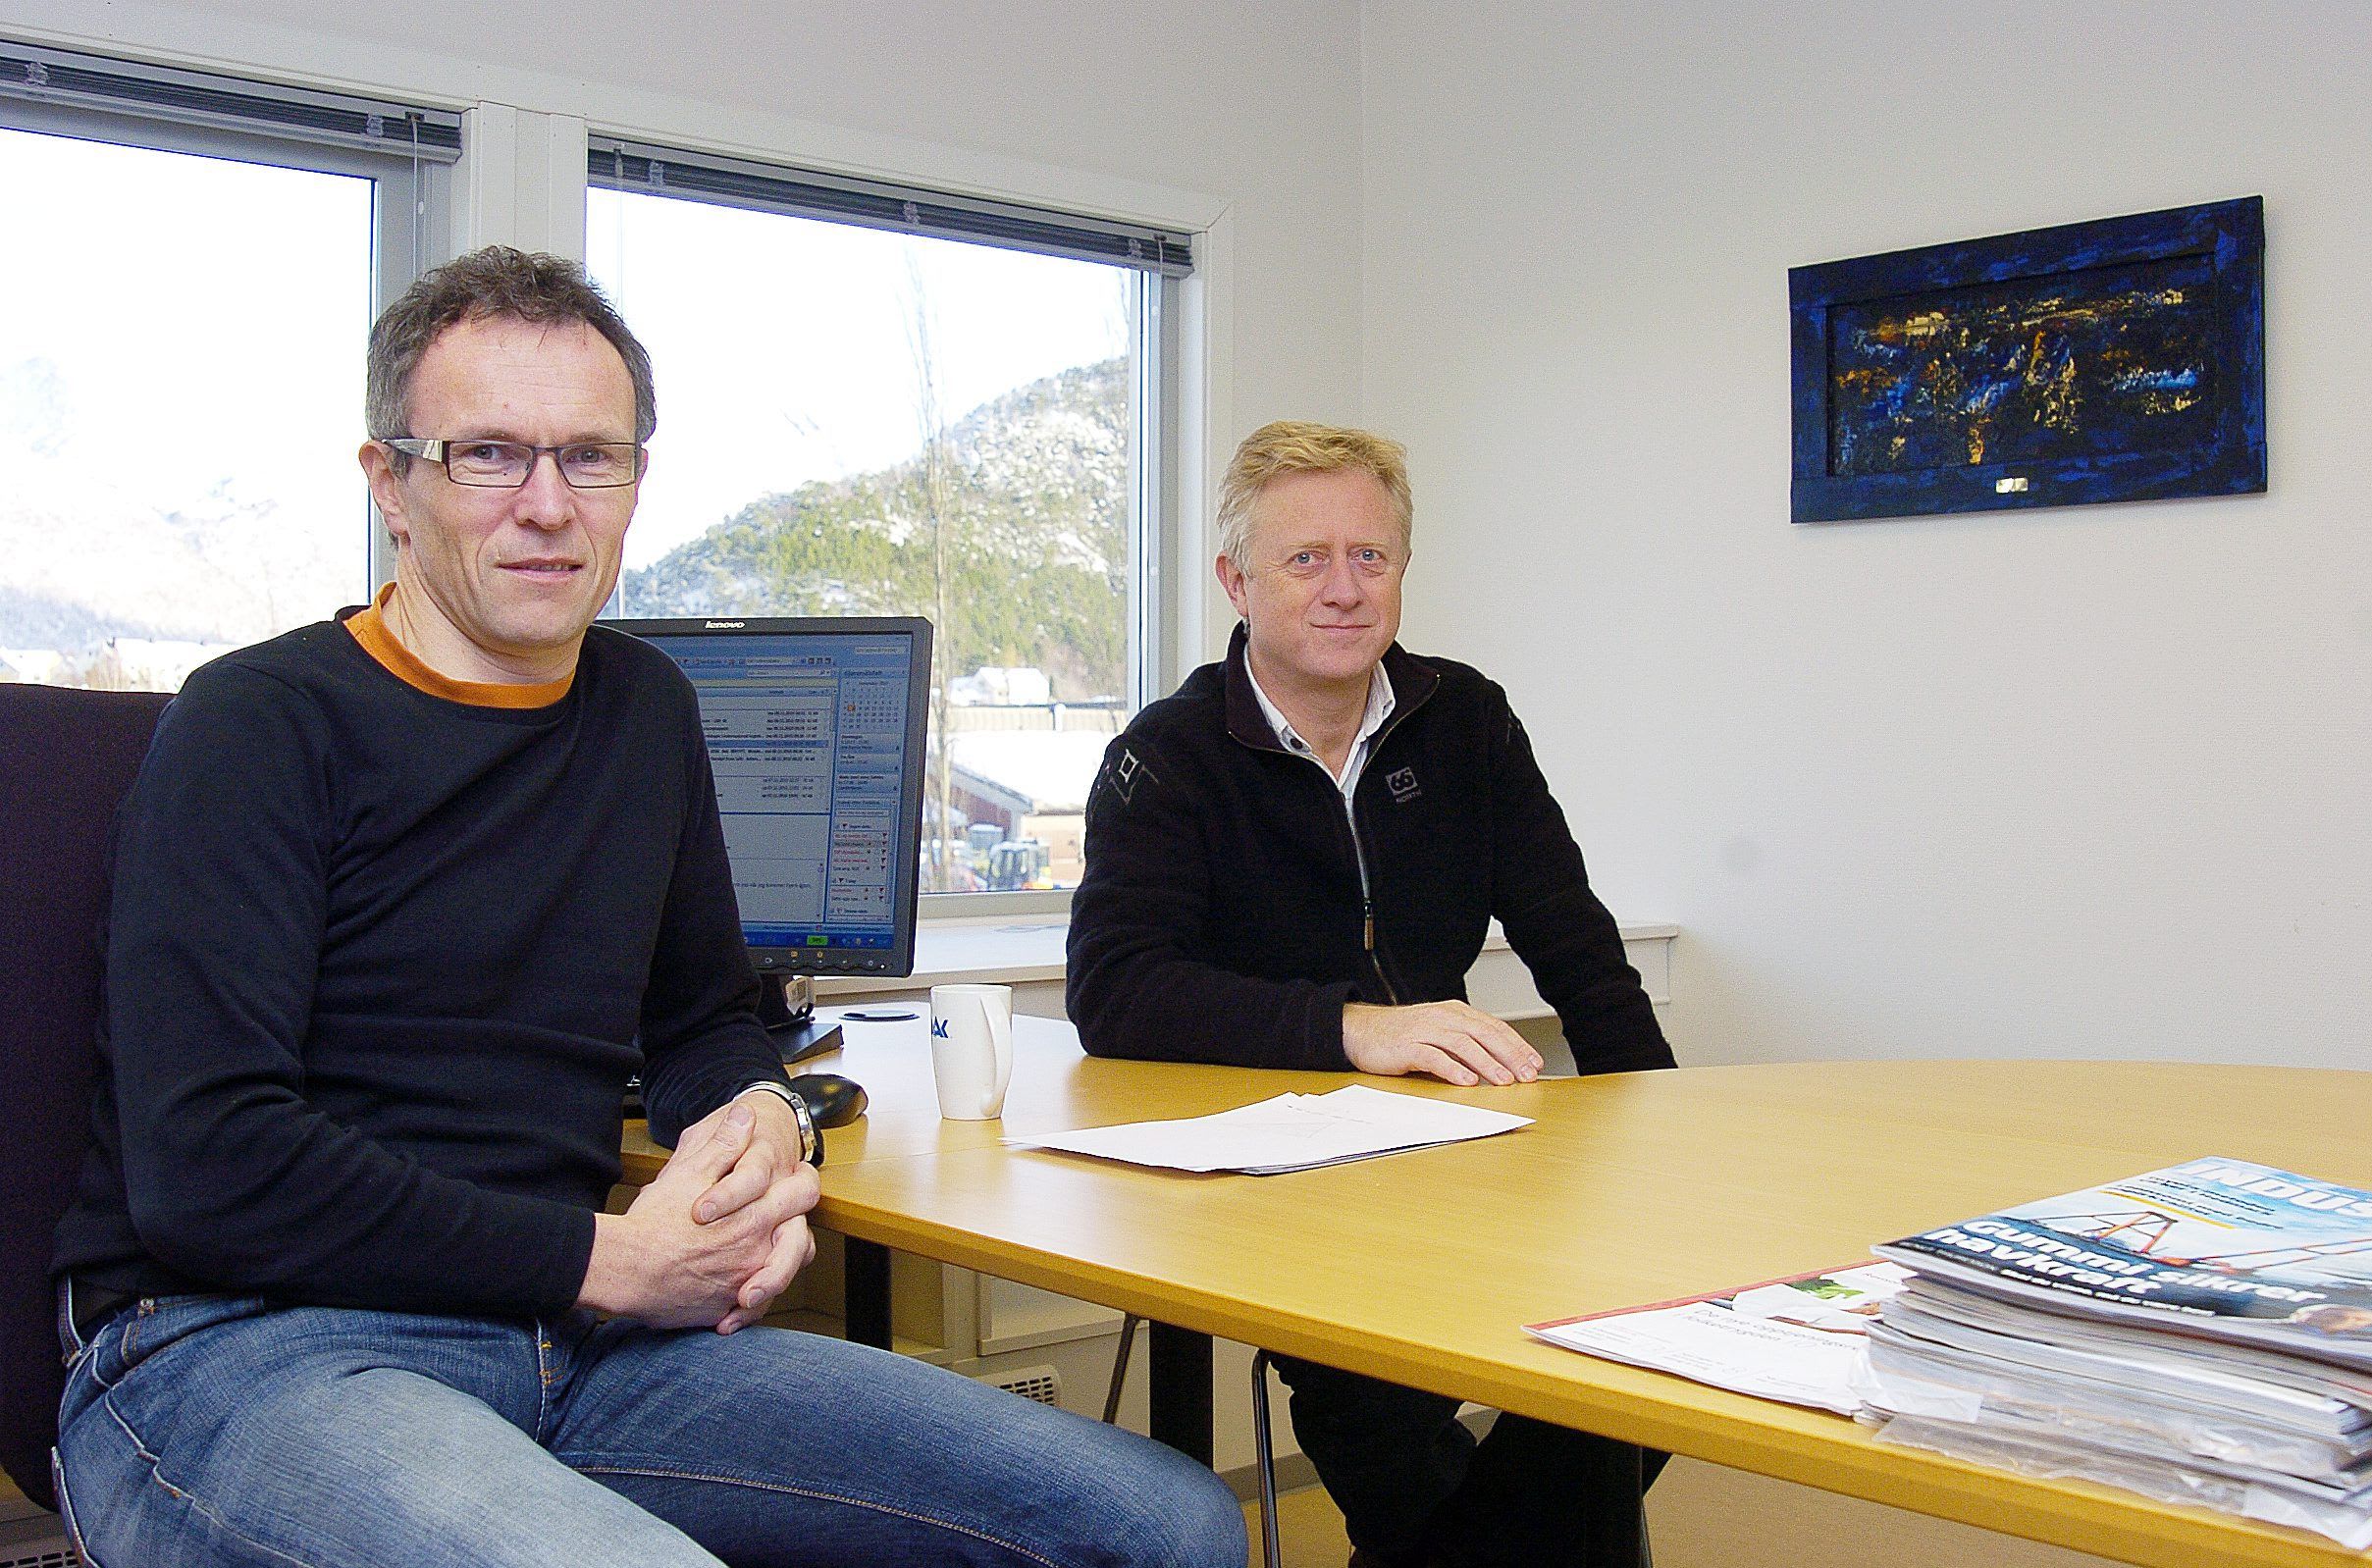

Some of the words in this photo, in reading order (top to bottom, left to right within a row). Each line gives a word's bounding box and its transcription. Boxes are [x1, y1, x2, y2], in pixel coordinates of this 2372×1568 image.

[705, 620, 746, 629] lenovo
[1923, 1228, 2162, 1294] havkraft
[1963, 1220, 2155, 1276] Gummi
[2148, 1271, 2328, 1303] sikrer
